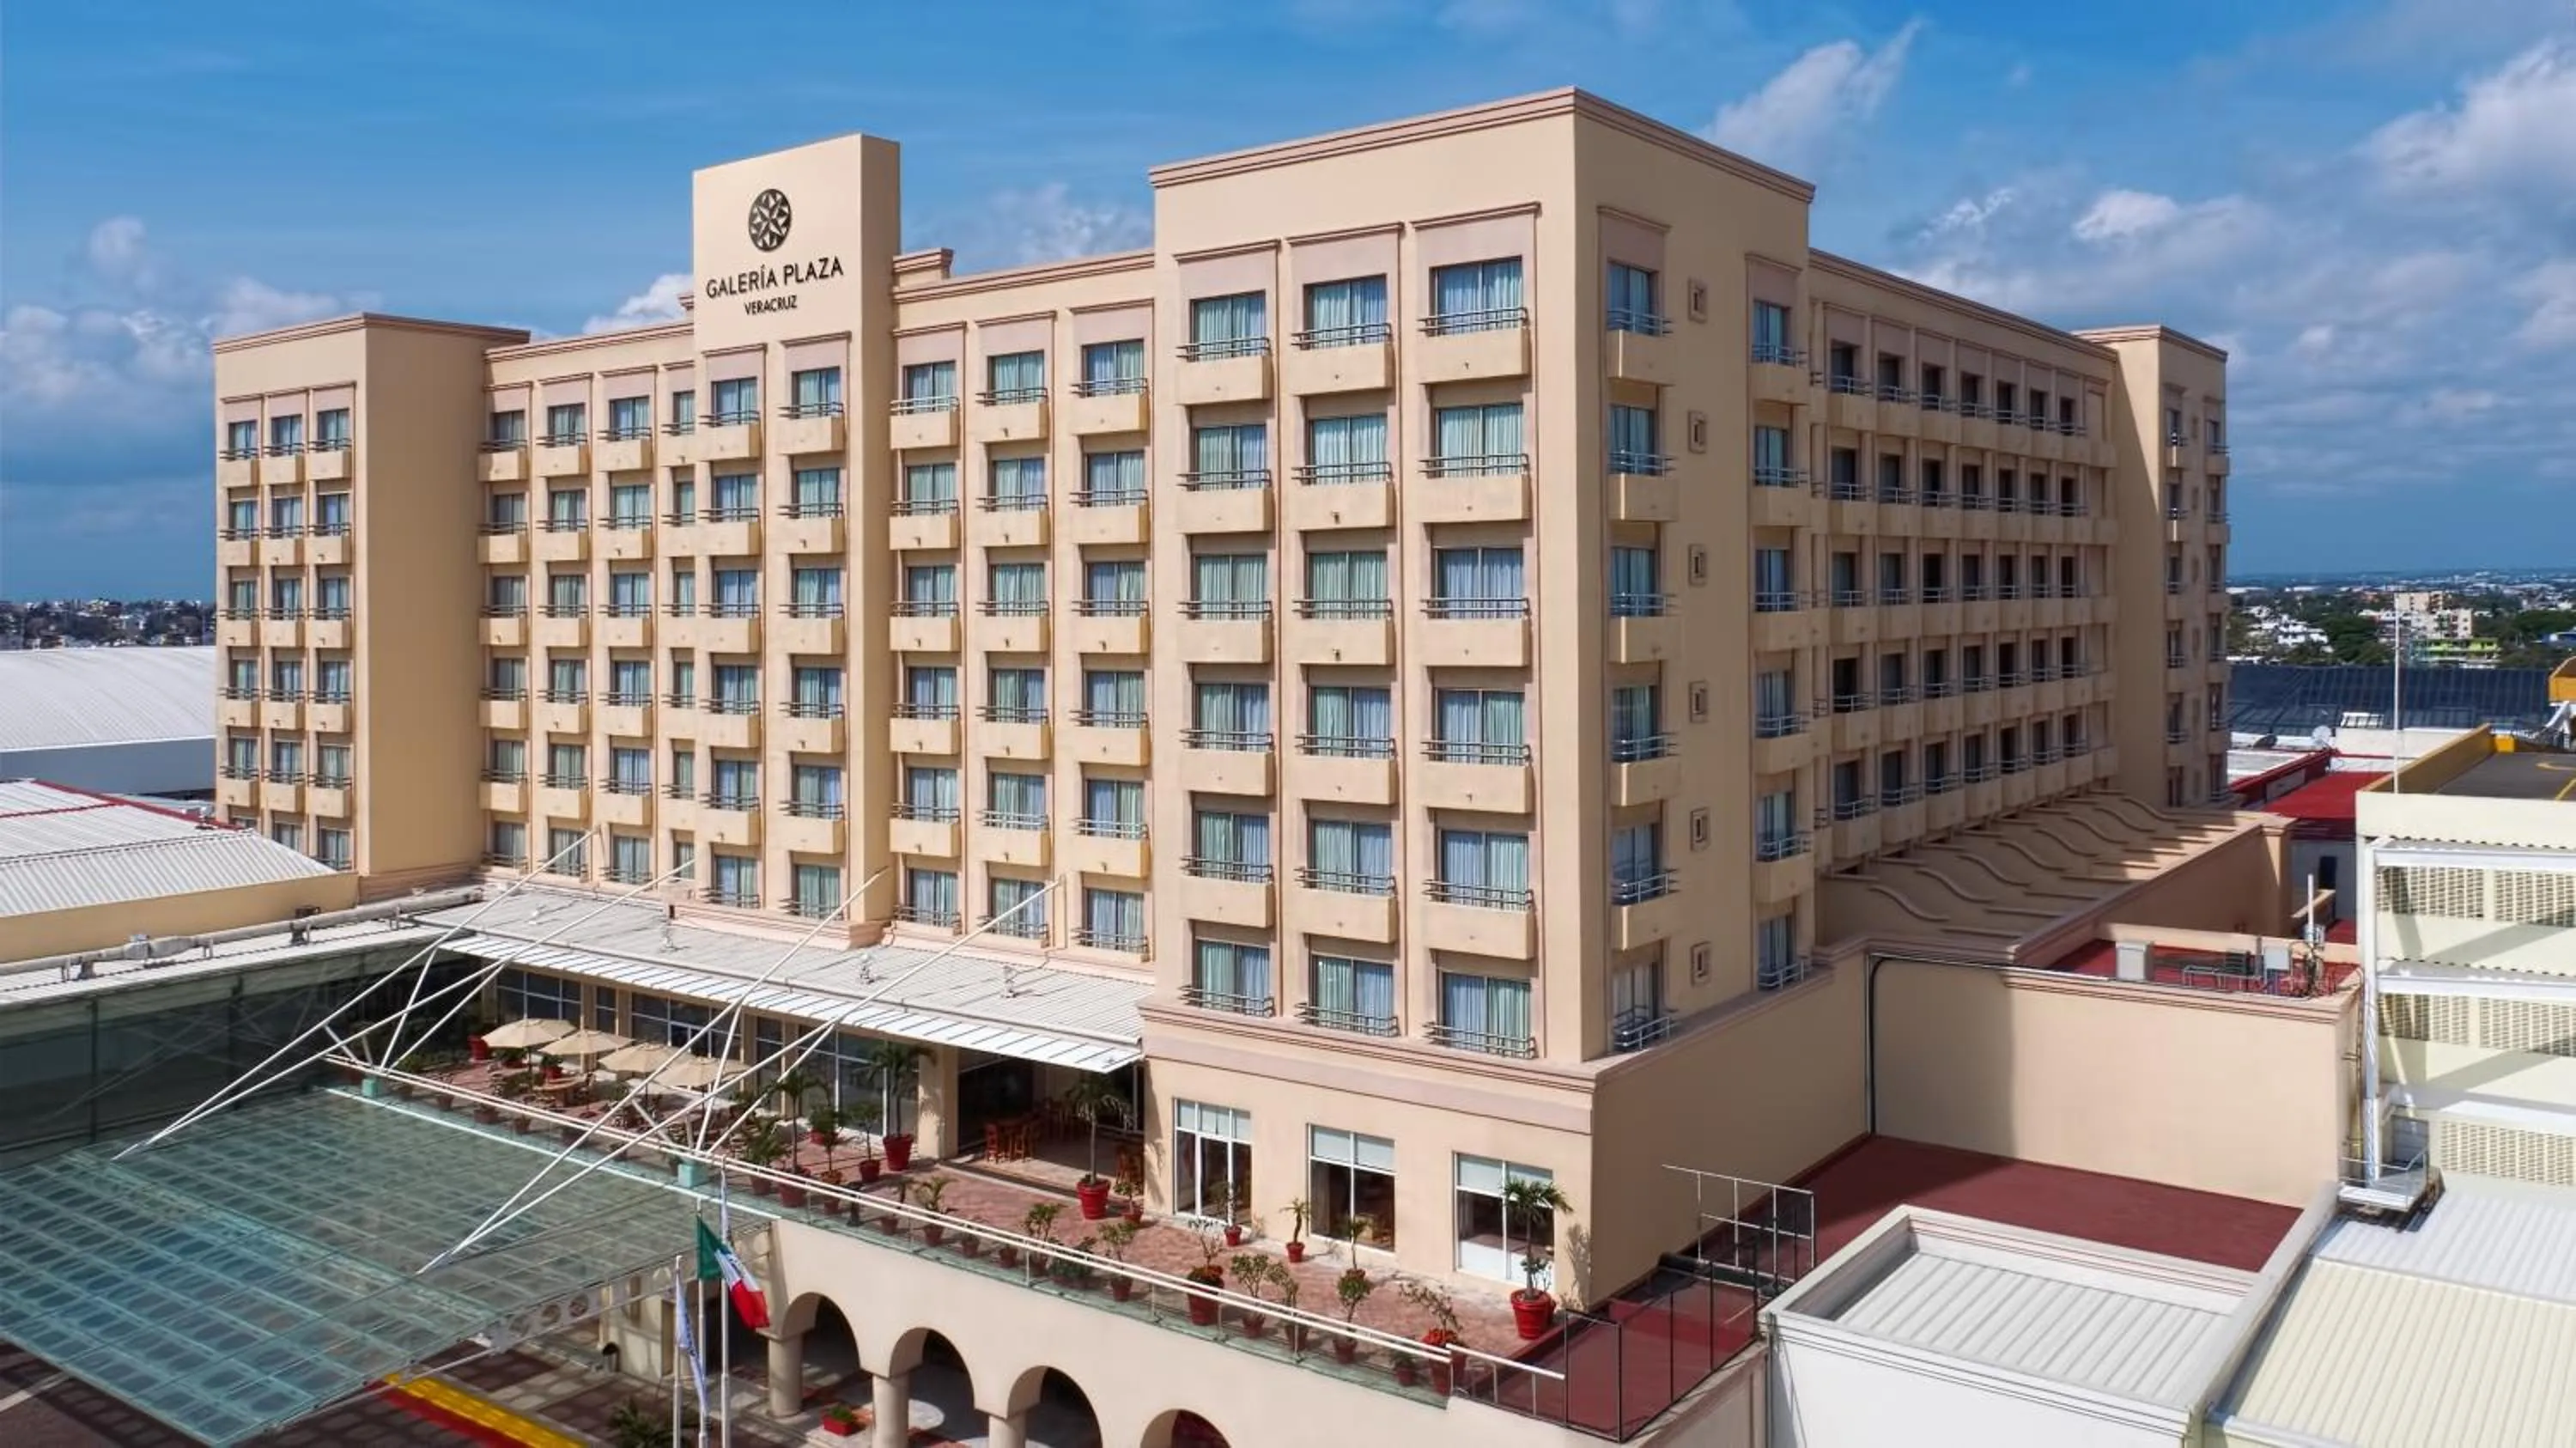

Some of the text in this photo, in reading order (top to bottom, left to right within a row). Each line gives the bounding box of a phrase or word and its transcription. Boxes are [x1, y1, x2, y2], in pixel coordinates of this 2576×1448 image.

[706, 256, 843, 299] GALERÍA PLAZA
[744, 295, 798, 315] VERACRUZ
